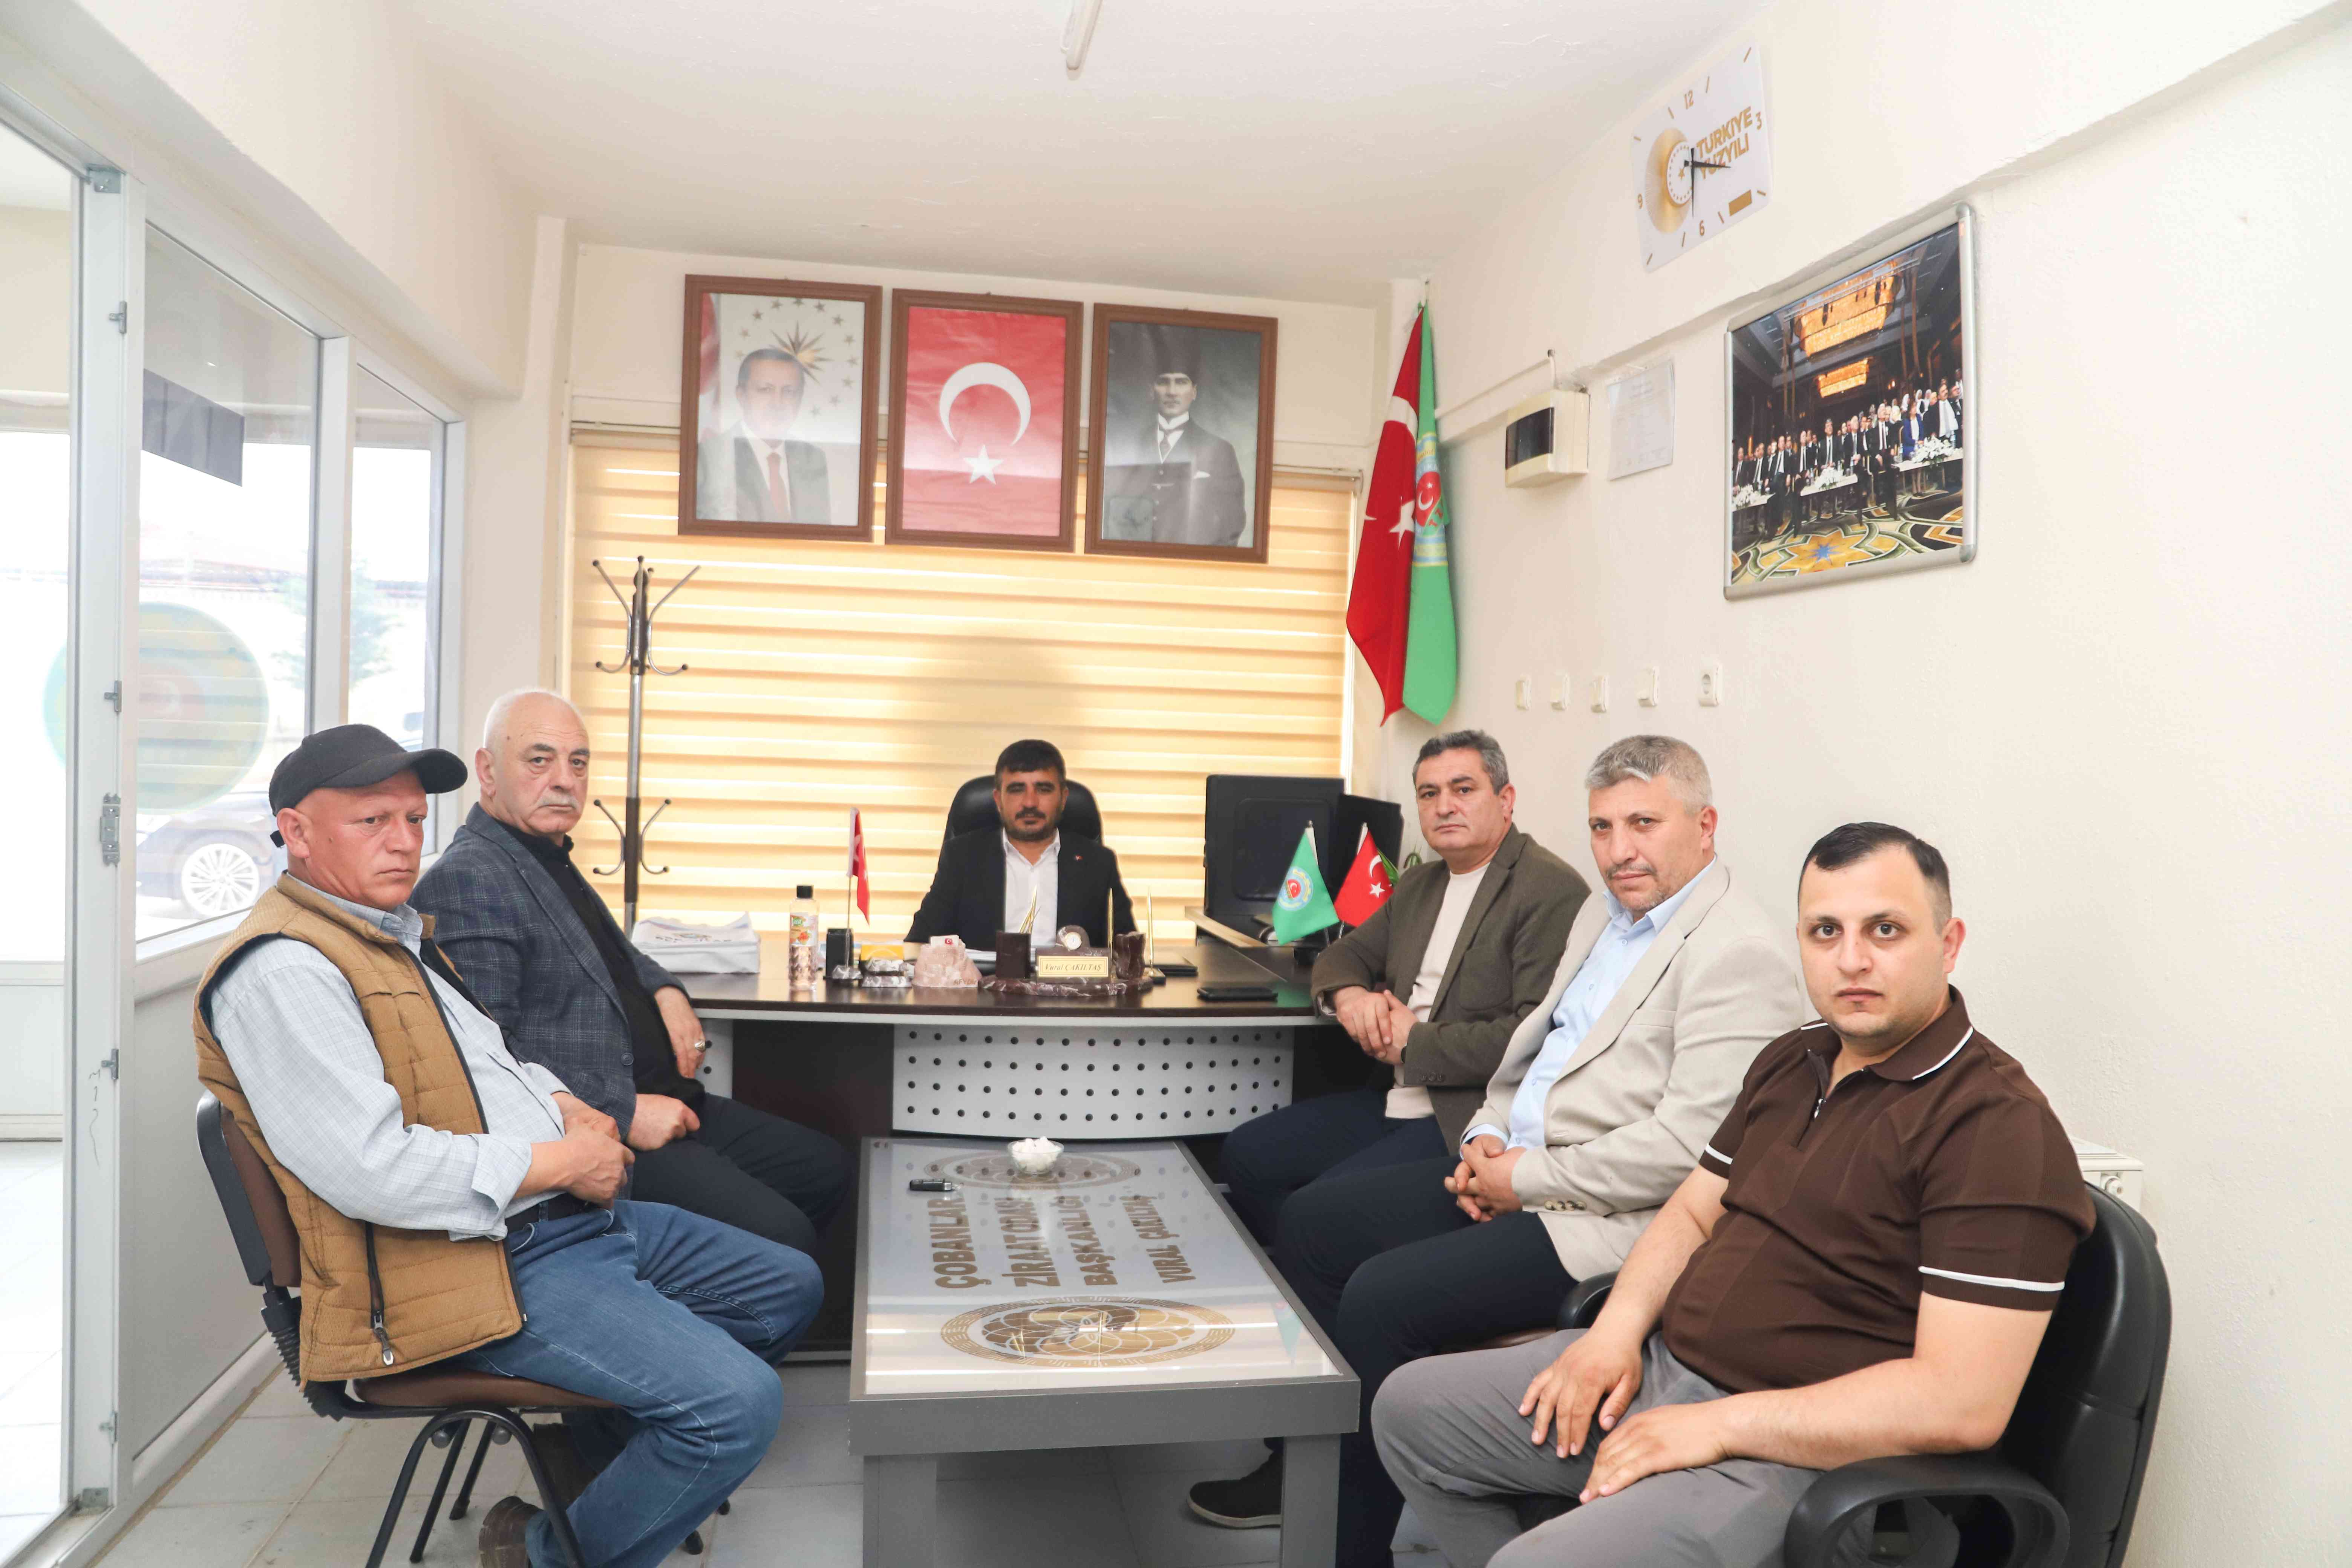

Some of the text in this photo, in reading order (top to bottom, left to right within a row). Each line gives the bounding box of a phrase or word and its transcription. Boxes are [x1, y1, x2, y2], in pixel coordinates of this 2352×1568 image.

[1684, 90, 1694, 110] 12
[1755, 112, 1762, 130] 3
[1637, 193, 1643, 209] 9
[1699, 219, 1704, 236] 6
[928, 1198, 992, 1288] ÇOBANLAR
[1051, 1196, 1118, 1285] BAŞKANLIĞI
[1119, 1195, 1196, 1283] VURAL ÇAKILTAŞ
[1001, 1235, 1061, 1286] ZİRAAT
